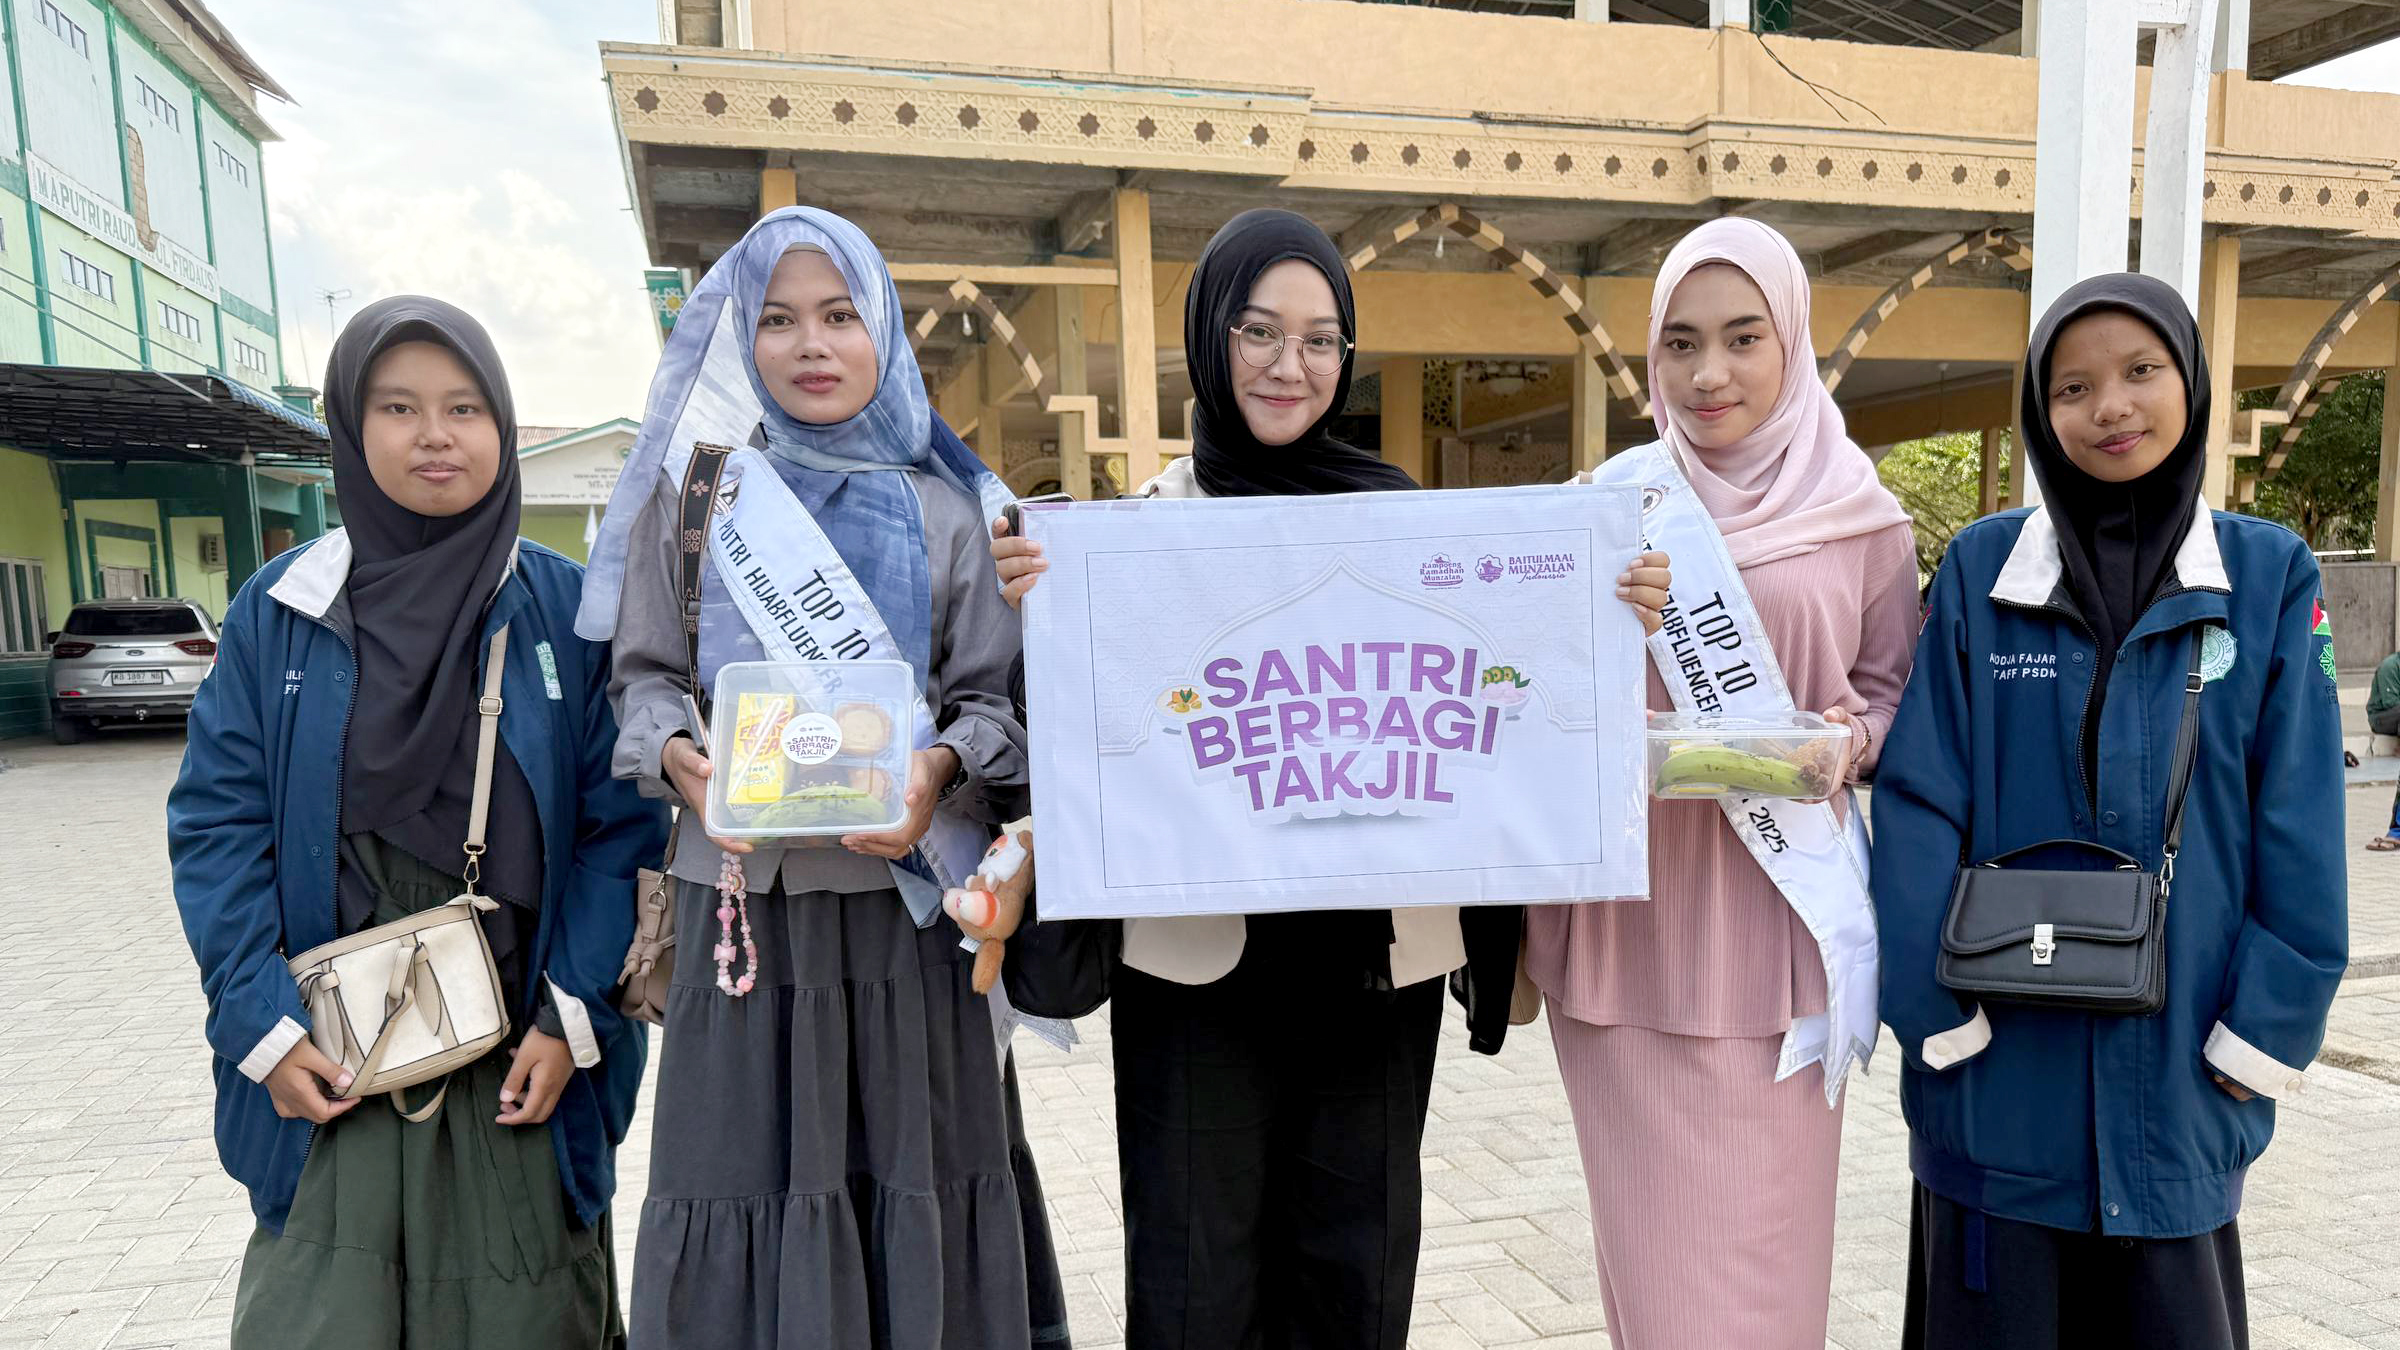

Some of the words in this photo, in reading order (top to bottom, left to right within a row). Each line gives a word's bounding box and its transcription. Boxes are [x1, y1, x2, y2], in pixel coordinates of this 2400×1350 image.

[103, 210, 170, 268] RAUDUL
[172, 249, 216, 294] FIRDAUS
[1420, 568, 1465, 576] Ramadhan
[1424, 574, 1461, 582] Munzalan
[1508, 553, 1575, 565] BAITULMAAL
[1508, 562, 1575, 575] MUNZALAN
[719, 518, 752, 566] PUTRI
[744, 567, 843, 693] HIJABFLUENER
[793, 569, 845, 621] TOP
[831, 628, 870, 660] 10
[1690, 591, 1742, 650] TOP
[1204, 642, 1478, 708] SANTRI
[1715, 659, 1757, 694] 10
[2019, 653, 2056, 664] FAJAR
[792, 735, 832, 744] SANTRI
[795, 748, 827, 757] TAKJIL
[1187, 696, 1499, 769] BERBAGI
[1233, 751, 1454, 811] TAKJIL
[1749, 806, 1789, 853] 2025
